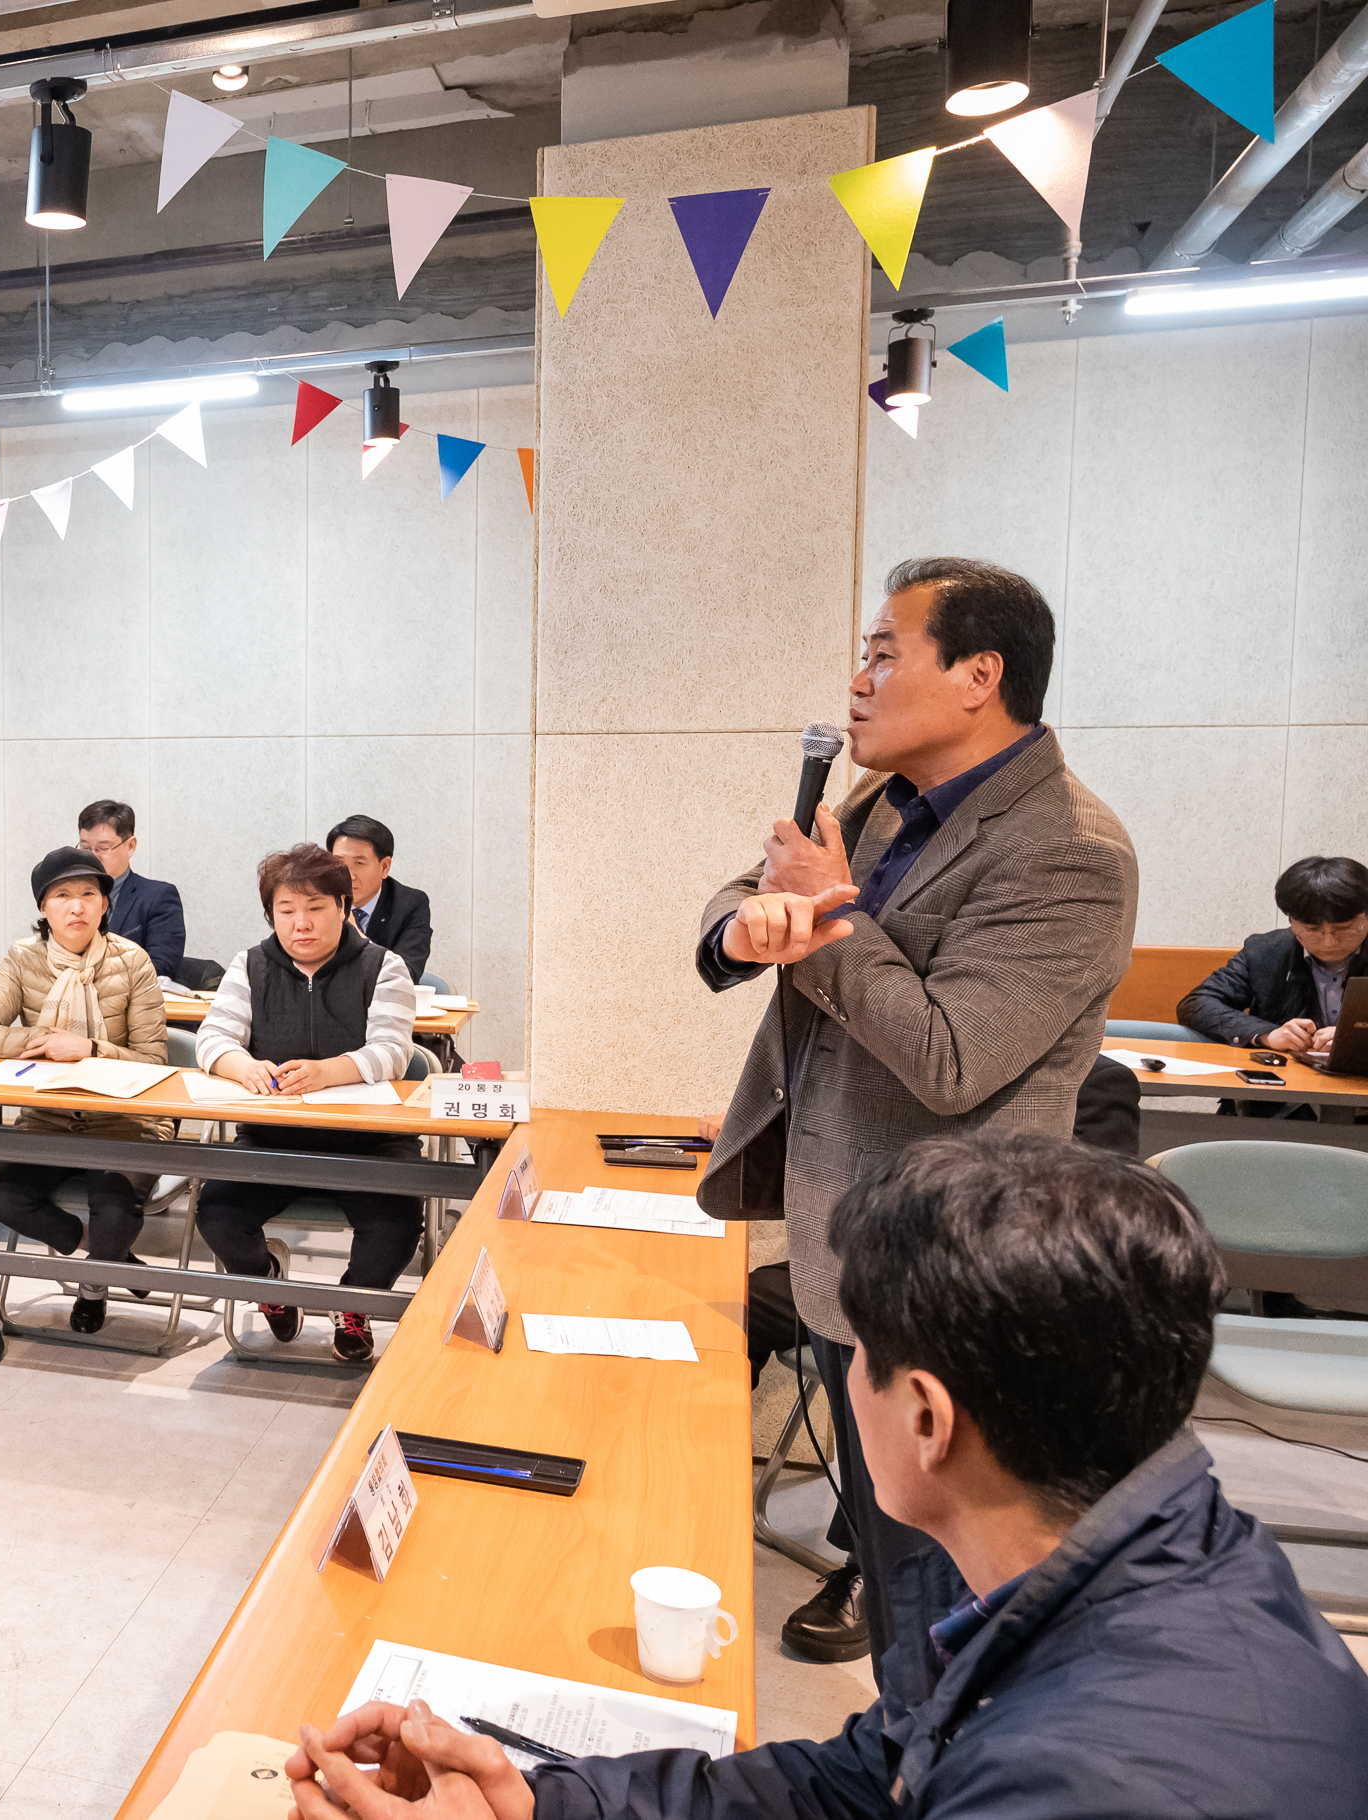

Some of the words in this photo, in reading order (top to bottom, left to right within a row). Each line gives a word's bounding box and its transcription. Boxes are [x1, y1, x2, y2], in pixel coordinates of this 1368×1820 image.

[458, 1083, 503, 1093] 20통장
[444, 1101, 517, 1120] 권명화
[377, 1478, 413, 1563] 김남화
